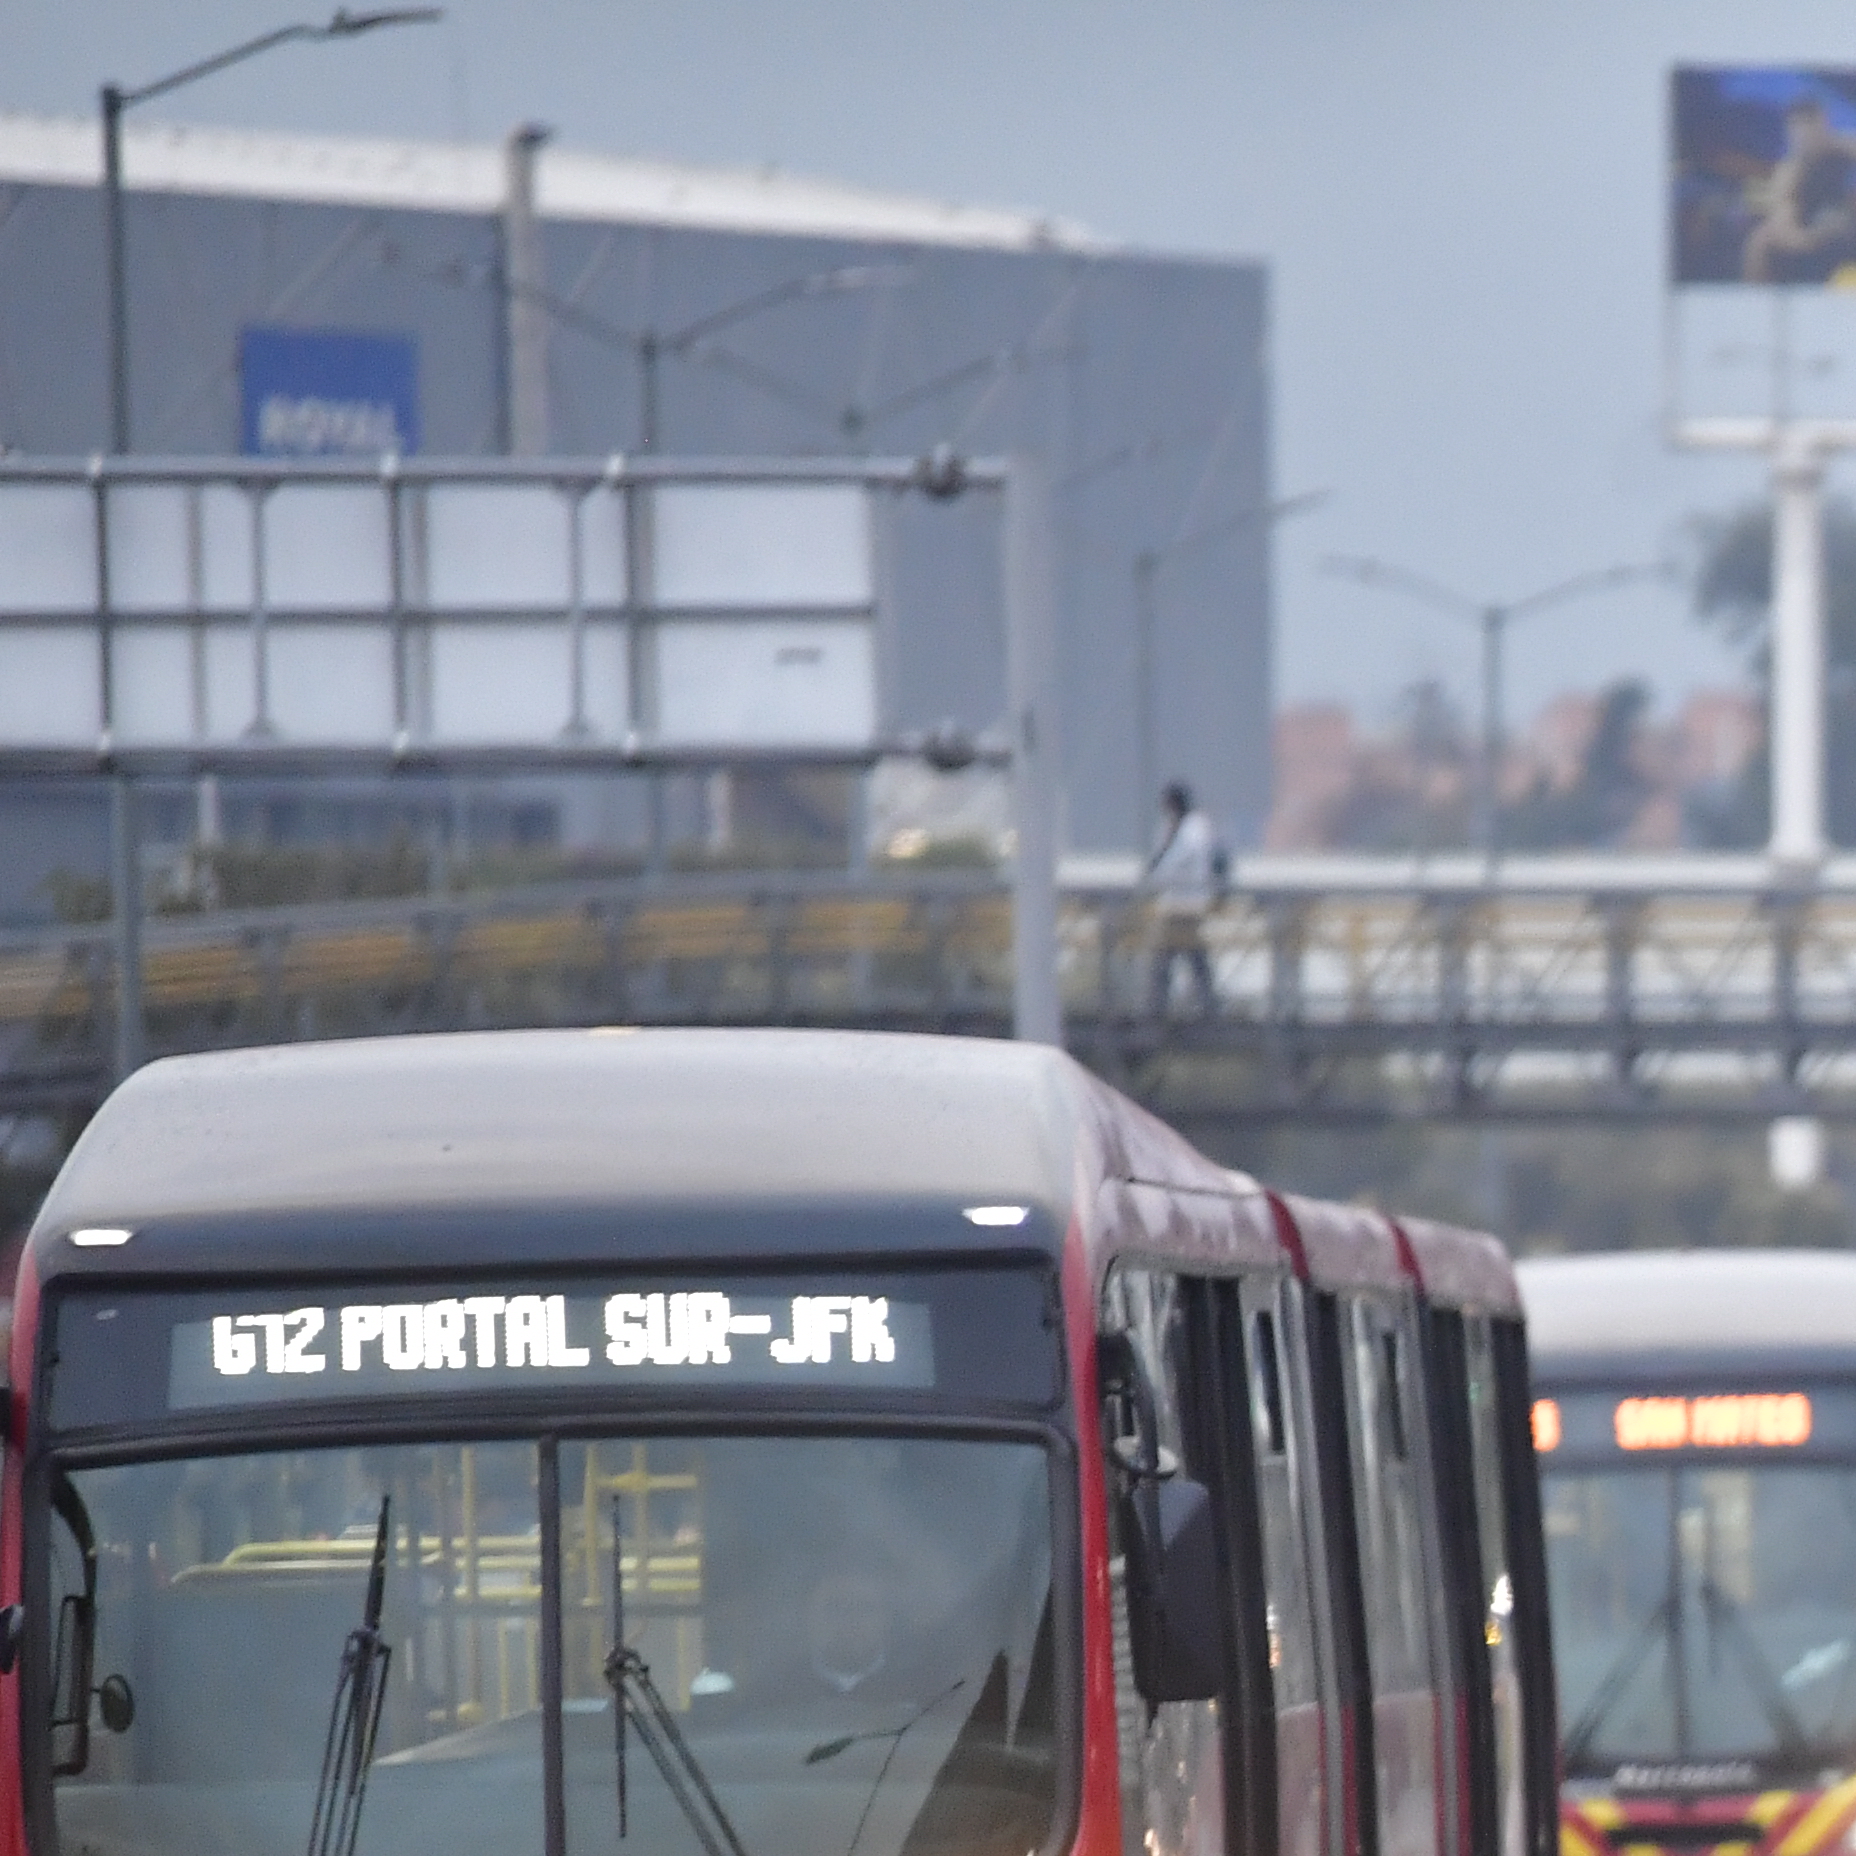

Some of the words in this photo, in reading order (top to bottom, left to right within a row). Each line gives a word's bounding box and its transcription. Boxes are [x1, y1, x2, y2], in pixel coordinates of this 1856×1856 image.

[212, 1307, 326, 1375] G12
[341, 1295, 590, 1371] PORTAL
[604, 1292, 895, 1366] SUR-JFK
